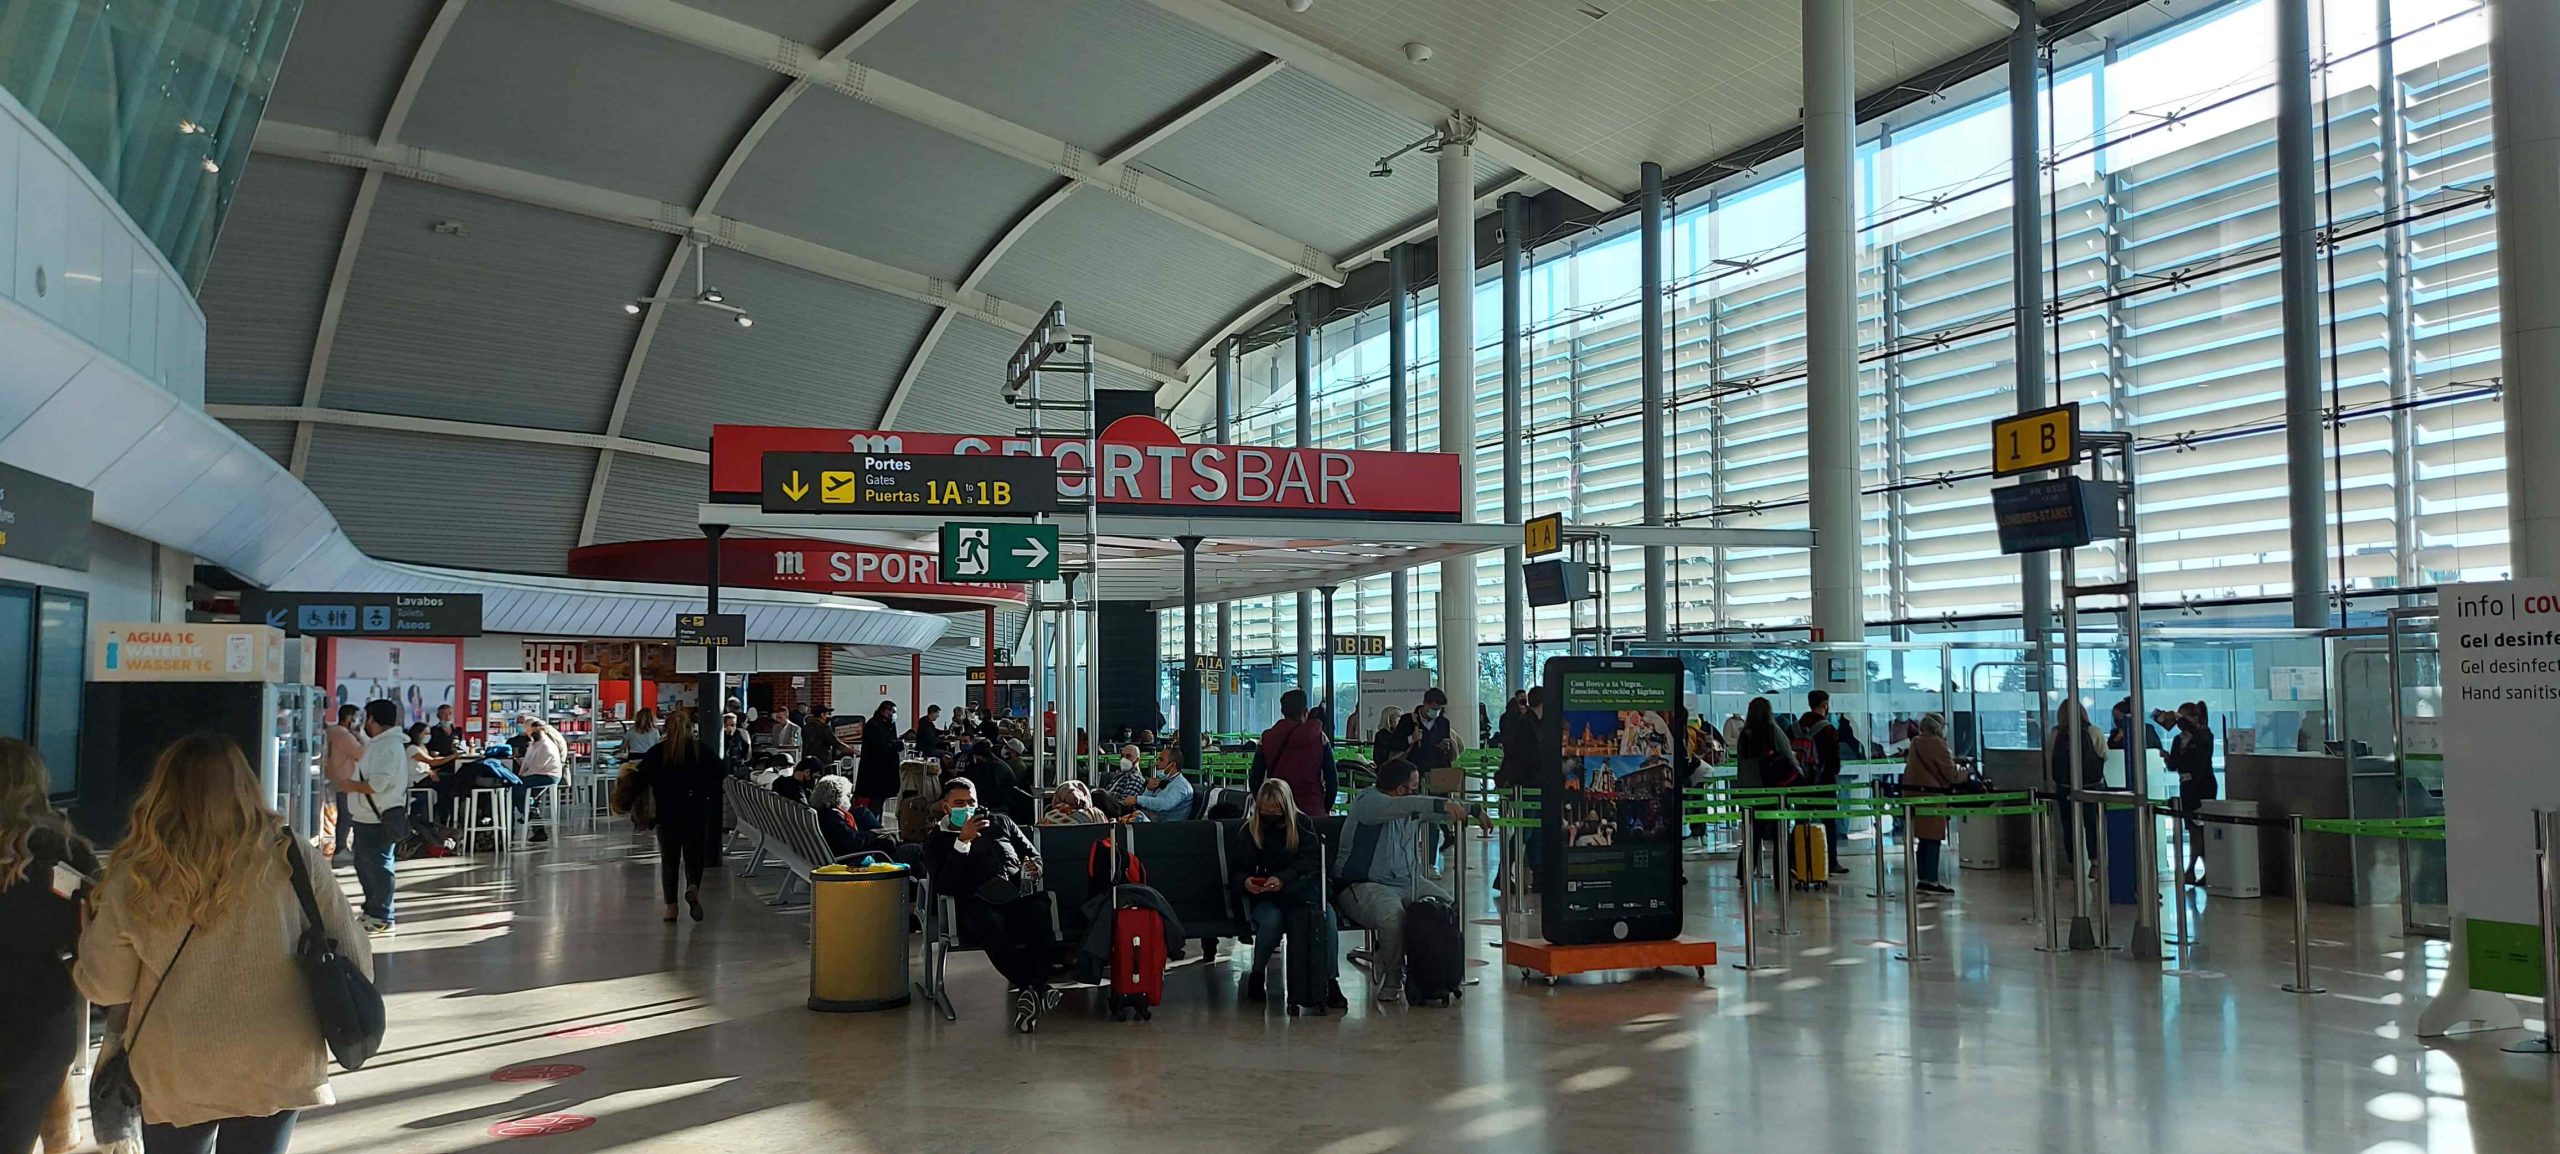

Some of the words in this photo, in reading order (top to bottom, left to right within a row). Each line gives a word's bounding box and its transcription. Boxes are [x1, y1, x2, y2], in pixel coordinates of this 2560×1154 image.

[2010, 430, 2021, 460] 1
[2040, 422, 2056, 454] B
[864, 457, 912, 471] Portes
[865, 474, 896, 486] Gates
[926, 480, 963, 505] 1A
[965, 483, 974, 492] to
[977, 481, 1011, 505] 1B
[865, 489, 920, 503] Puertas
[966, 496, 973, 504] a
[1543, 525, 1551, 545] A
[396, 596, 444, 606] Lavabos
[2457, 595, 2504, 617] info
[397, 620, 431, 630] Aseos
[126, 632, 173, 644] AGUA
[177, 632, 195, 644] 1€
[698, 636, 712, 645] 1A
[715, 636, 729, 645] 1B
[2460, 633, 2488, 648] Gel
[128, 645, 180, 658] WATER
[1335, 637, 1356, 654] 1B
[1362, 638, 1383, 654] 1B
[126, 659, 192, 672] WASSER
[523, 644, 577, 673] BEER
[1208, 658, 1224, 670] 1A
[2461, 659, 2484, 674] Gel
[2462, 685, 2501, 700] Hand
[2506, 684, 2560, 700] sanitis
